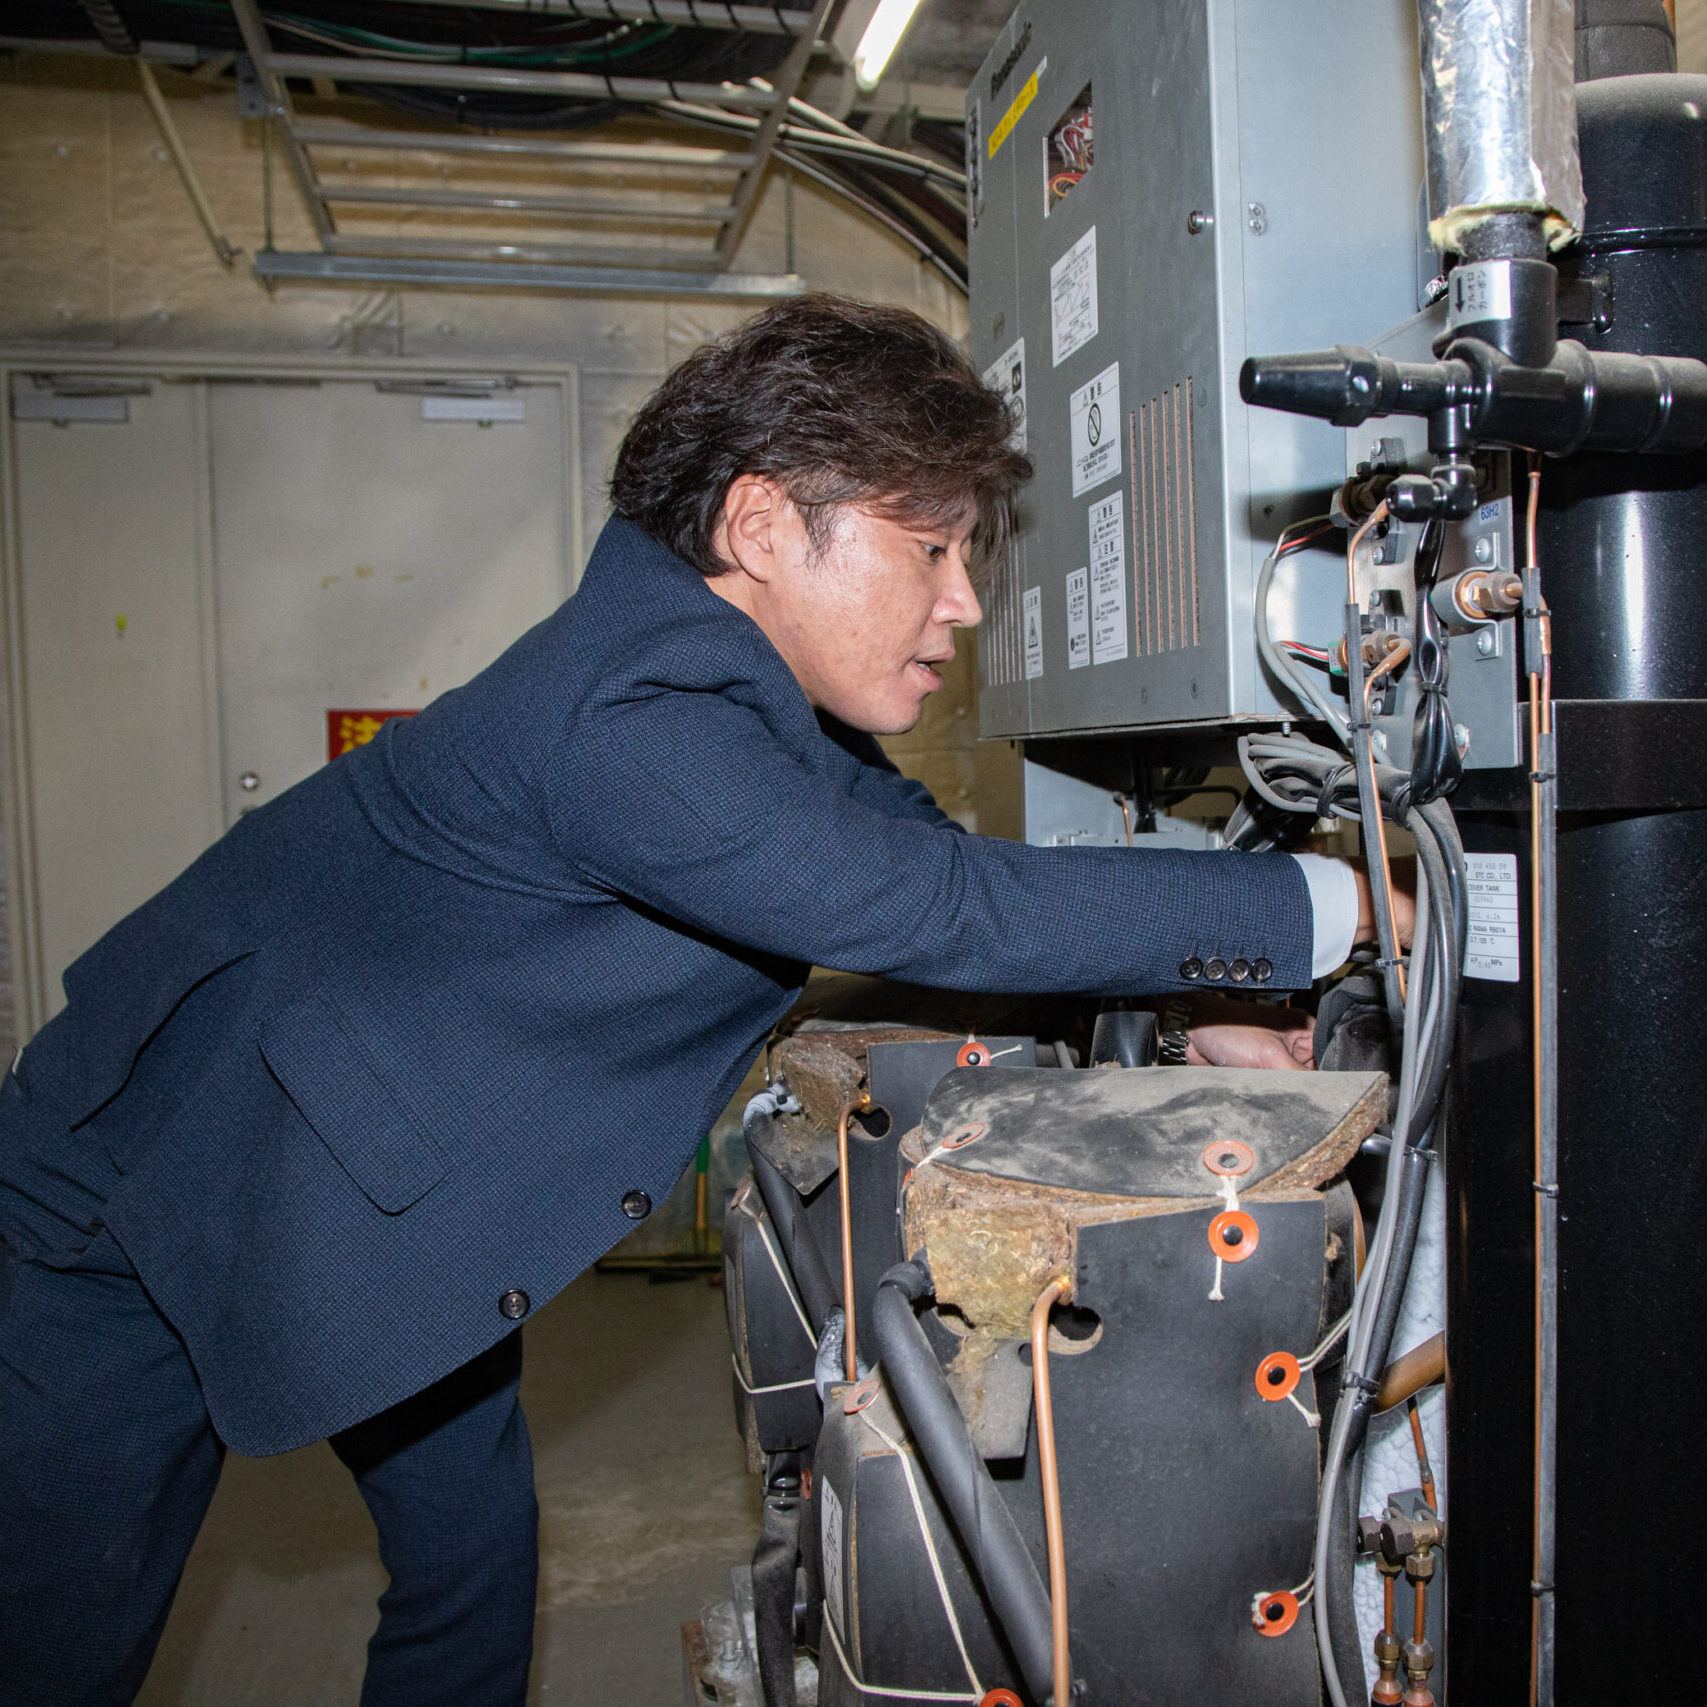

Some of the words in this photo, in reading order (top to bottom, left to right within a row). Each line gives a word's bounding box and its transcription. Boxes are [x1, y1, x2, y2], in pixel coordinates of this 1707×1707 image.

[1477, 269, 1488, 311] カーボン
[1480, 503, 1500, 520] 63H2
